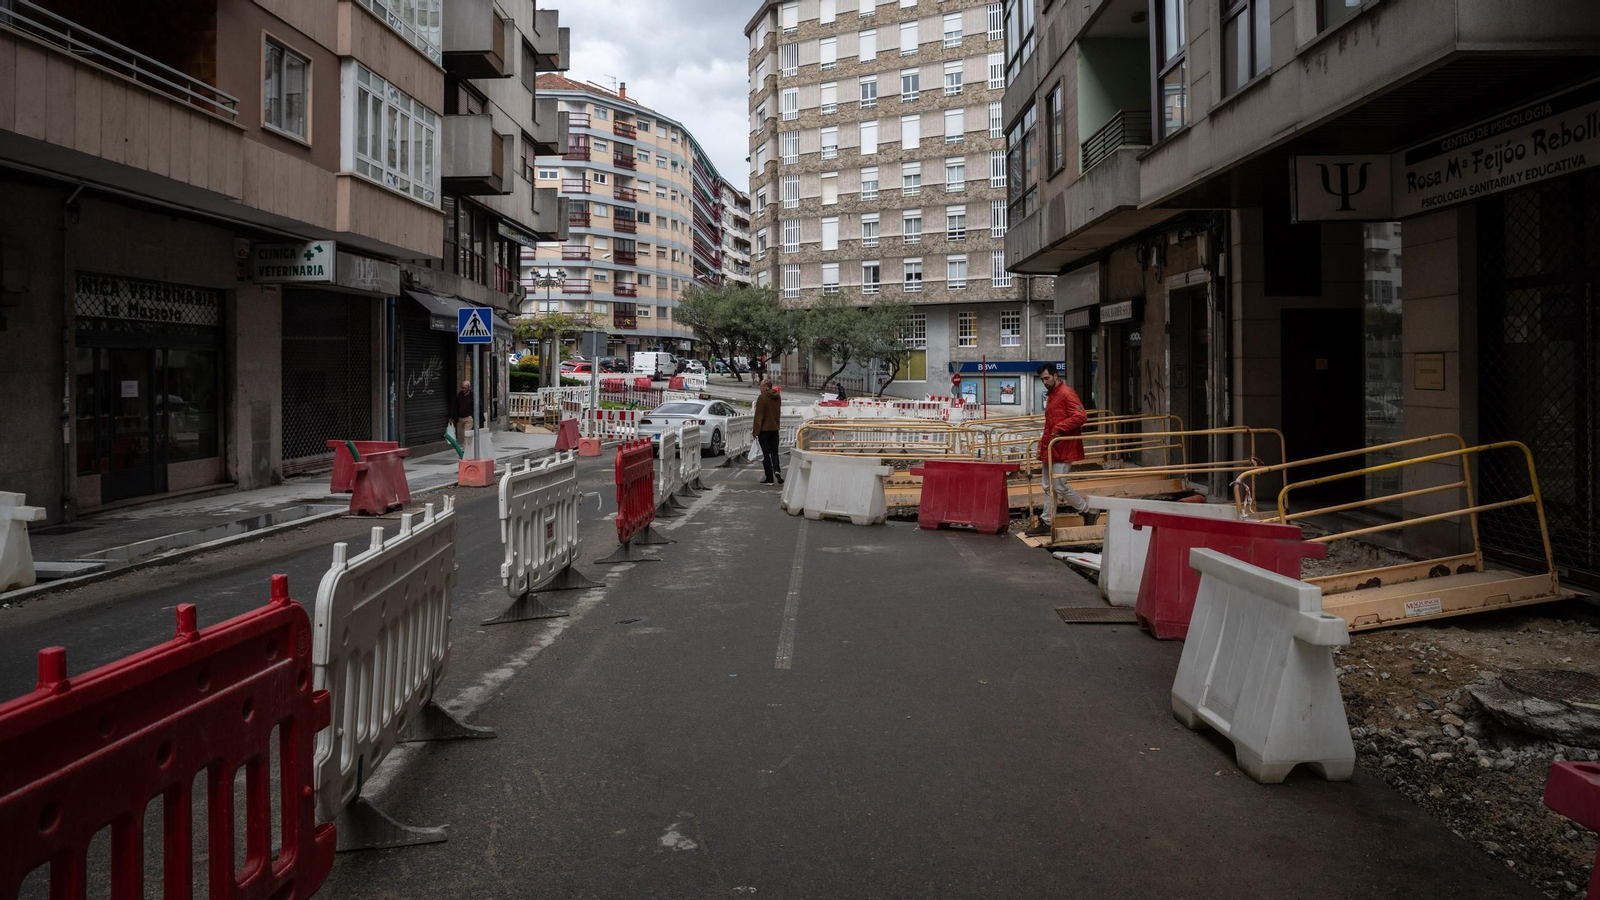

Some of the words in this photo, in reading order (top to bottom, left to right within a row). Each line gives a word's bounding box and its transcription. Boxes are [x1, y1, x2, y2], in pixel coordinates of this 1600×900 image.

[1441, 131, 1475, 152] CENTRO
[1477, 125, 1489, 138] DE
[1491, 103, 1552, 136] PSICOLOGIA
[1406, 169, 1442, 194] Rosa
[1446, 156, 1468, 180] Mª
[1472, 140, 1526, 175] Feijóo
[1531, 110, 1600, 156] Reboll
[1421, 187, 1468, 209] PSICOLOGIA
[1469, 175, 1517, 196] SANITARIA
[1516, 171, 1524, 184] Y
[1525, 153, 1586, 181] EDUCATIVA
[258, 248, 296, 260] CLINICA
[258, 265, 324, 277] VETERINARIA
[128, 282, 216, 308] VETERINARIA
[104, 297, 119, 317] La
[128, 302, 182, 322] Mascota
[978, 363, 998, 371] BBVA
